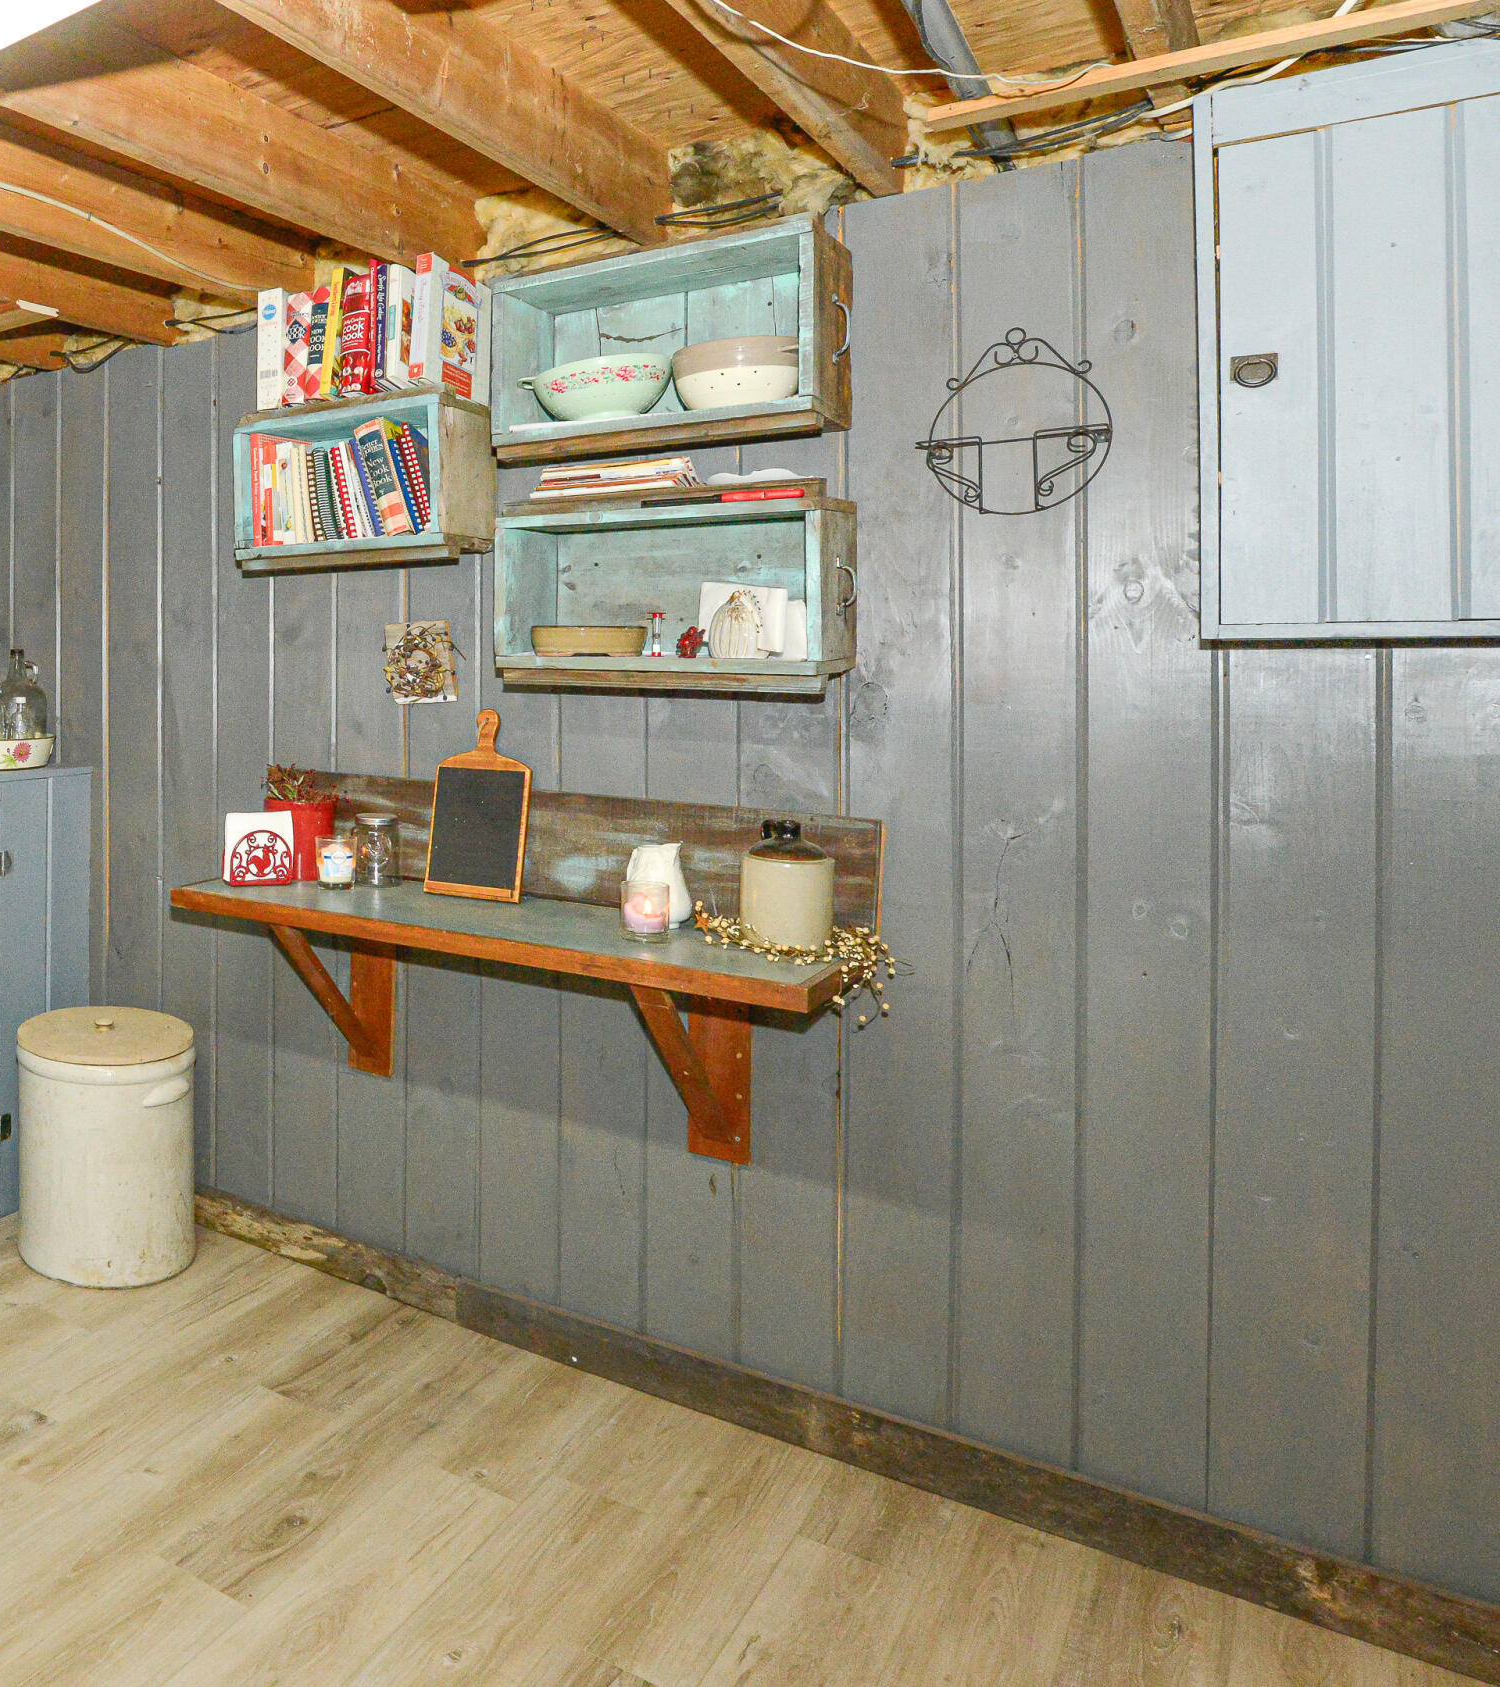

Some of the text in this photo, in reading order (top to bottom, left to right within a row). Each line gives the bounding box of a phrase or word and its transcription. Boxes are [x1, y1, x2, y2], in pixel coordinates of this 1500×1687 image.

[343, 320, 365, 334] cook
[341, 328, 364, 342] book
[366, 456, 384, 467] New
